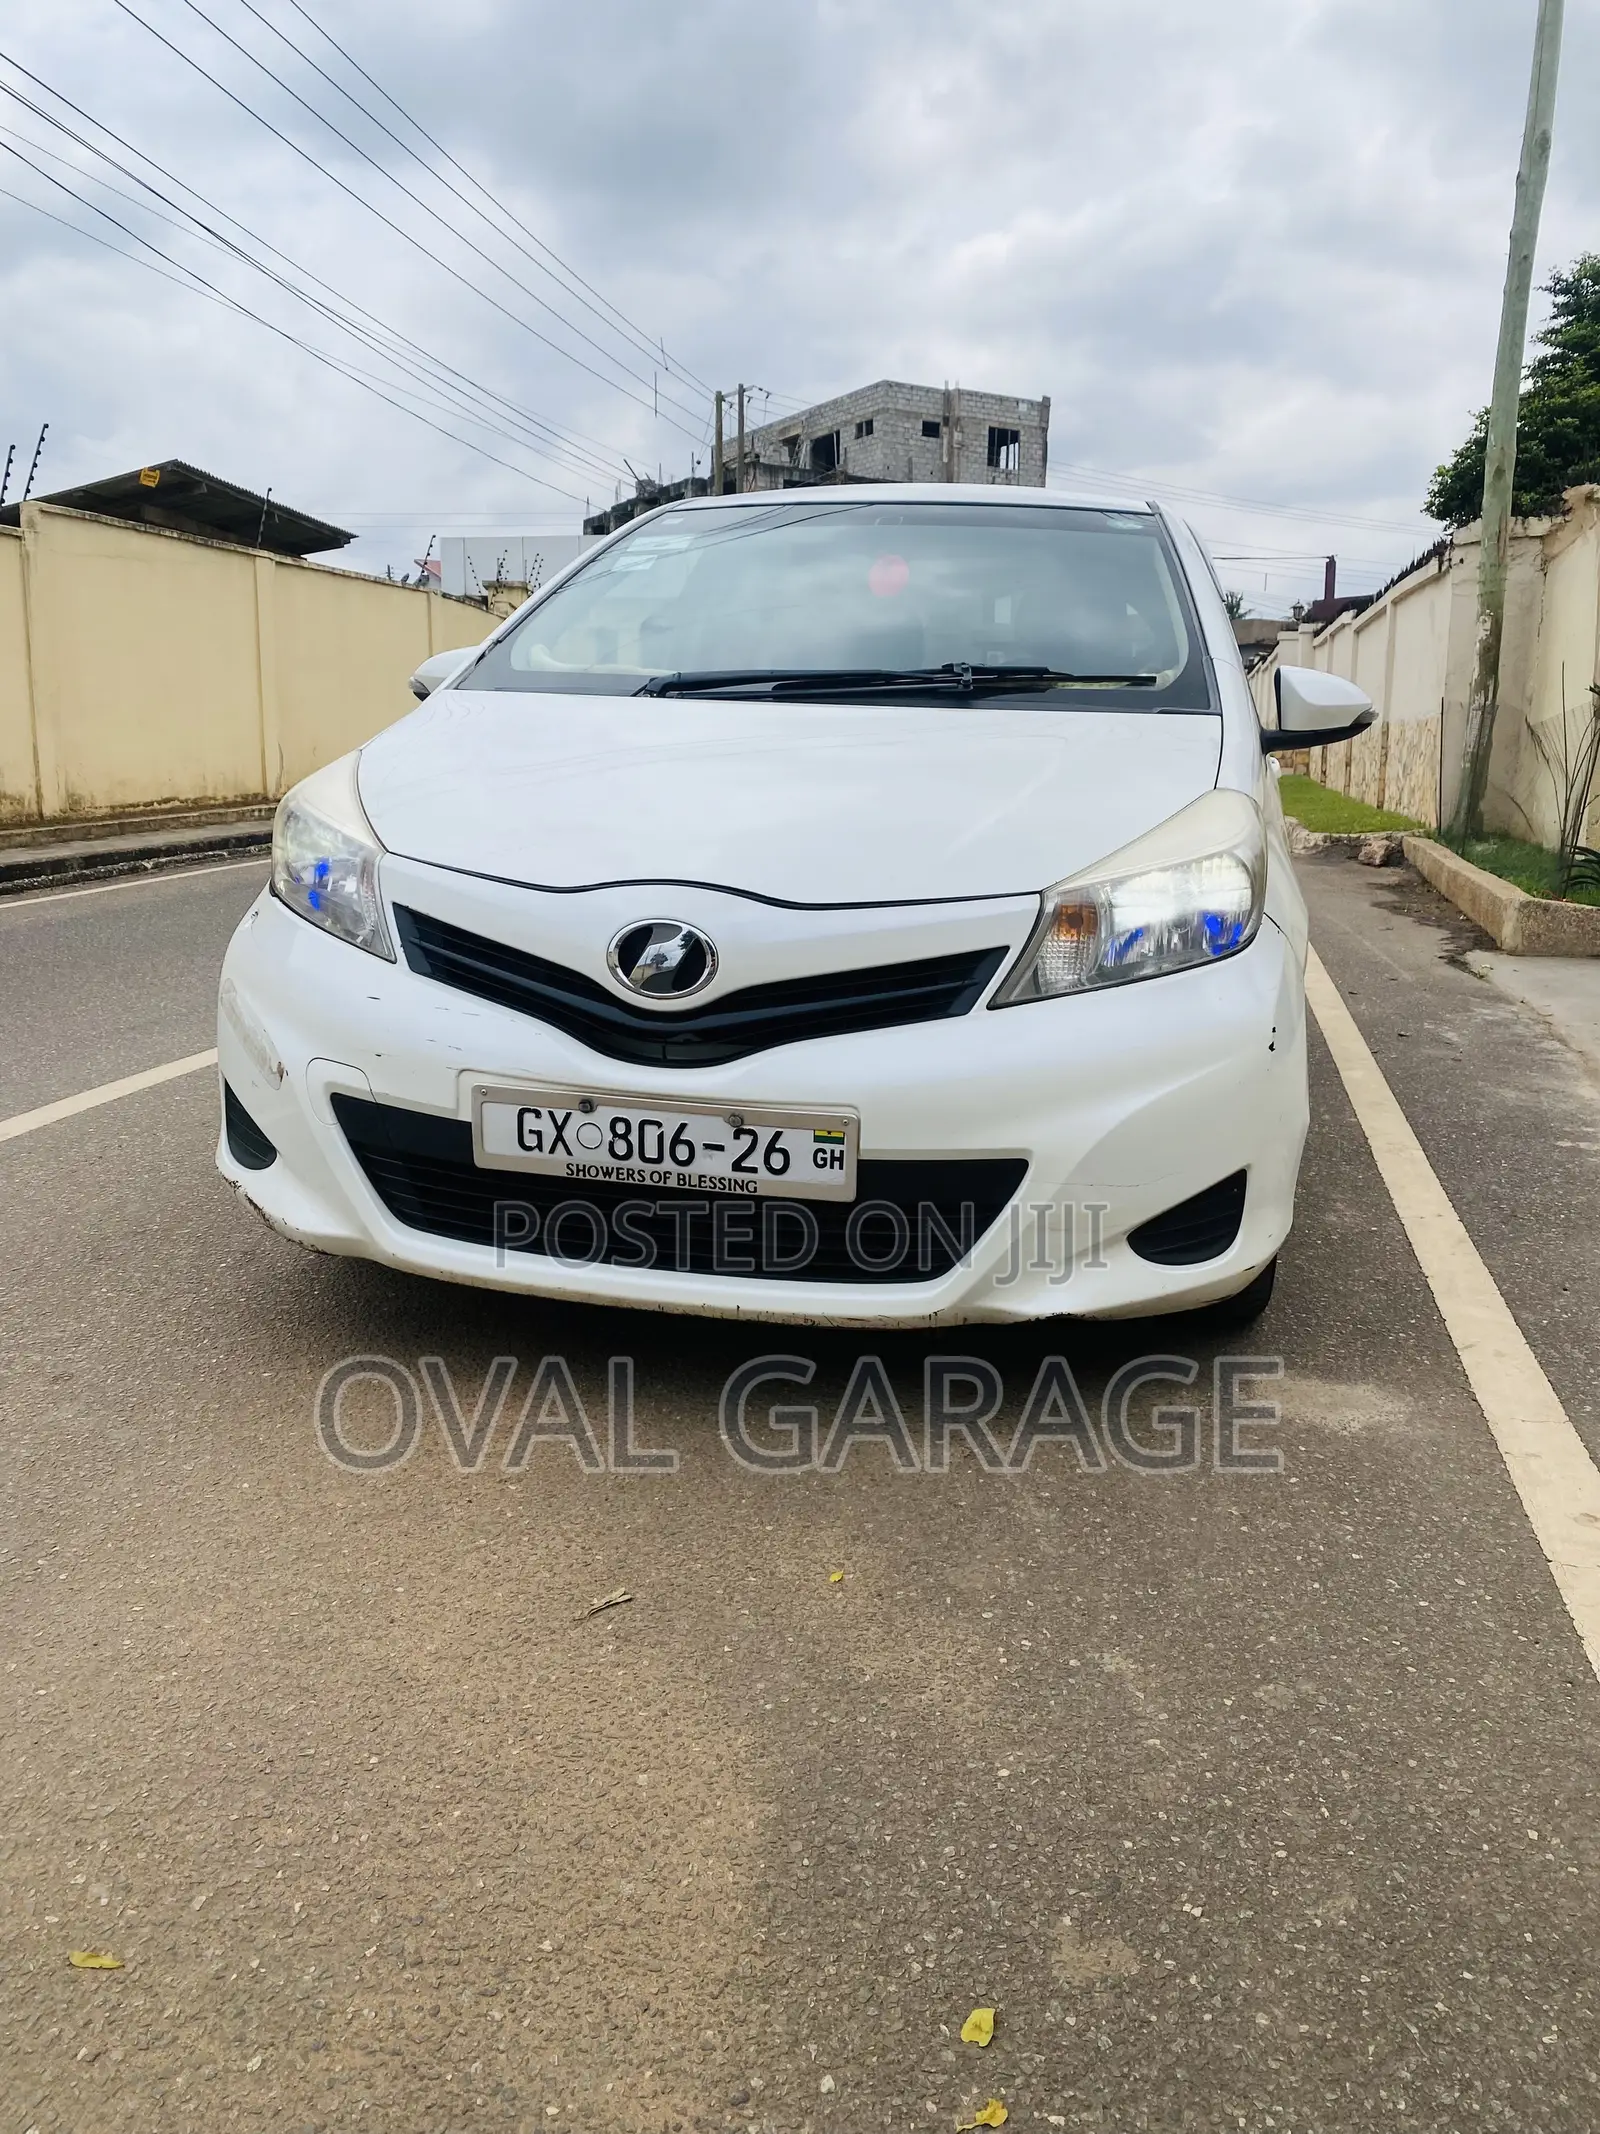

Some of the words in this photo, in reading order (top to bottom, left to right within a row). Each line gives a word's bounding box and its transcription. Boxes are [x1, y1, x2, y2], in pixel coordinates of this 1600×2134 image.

[516, 1106, 573, 1156] GX
[607, 1115, 791, 1176] 806-26
[812, 1148, 844, 1170] GH
[565, 1163, 646, 1183] SHOWERS
[649, 1171, 673, 1185] OF
[677, 1174, 758, 1194] BLESSING
